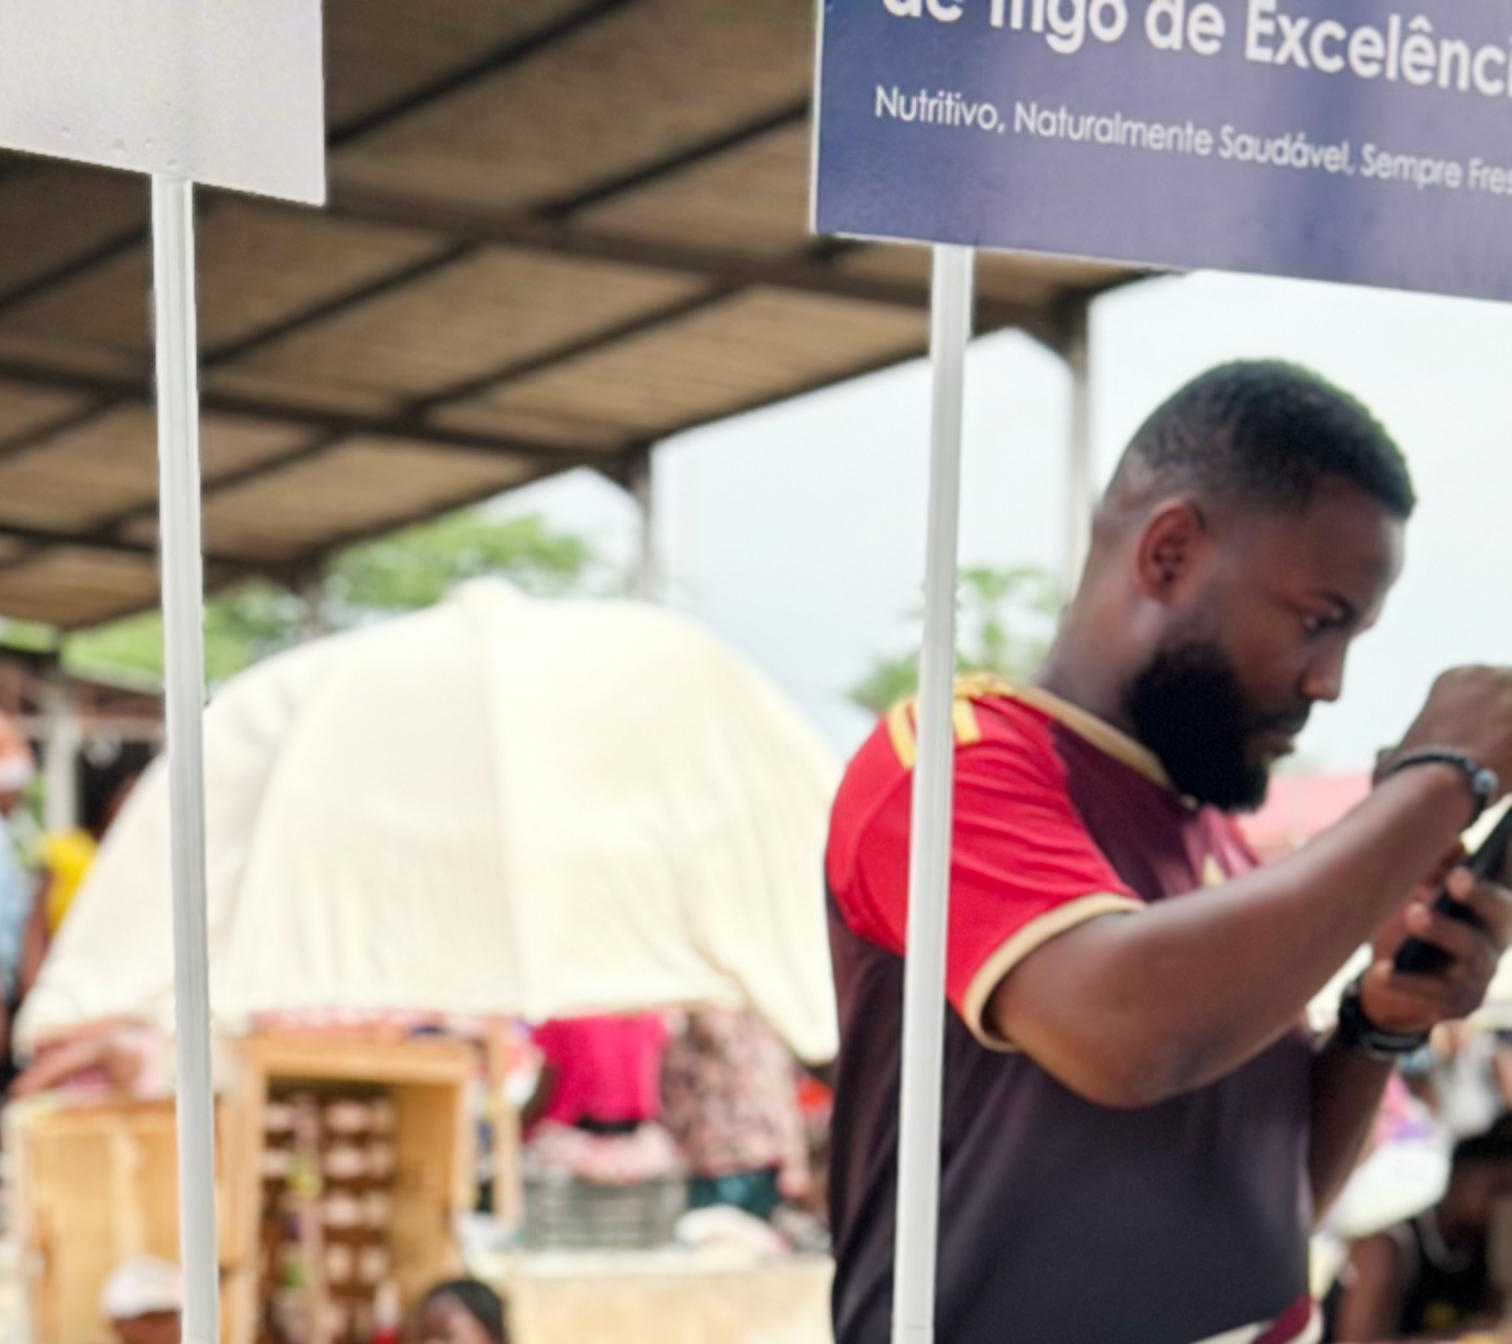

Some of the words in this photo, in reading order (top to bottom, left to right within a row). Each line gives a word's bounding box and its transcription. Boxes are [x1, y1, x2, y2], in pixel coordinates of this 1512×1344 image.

[875, 85, 1005, 134] Nutritivo,
[1014, 101, 1212, 156] Naturalmente
[1218, 124, 1355, 176] Saudável,
[1360, 143, 1462, 190] Sempre
